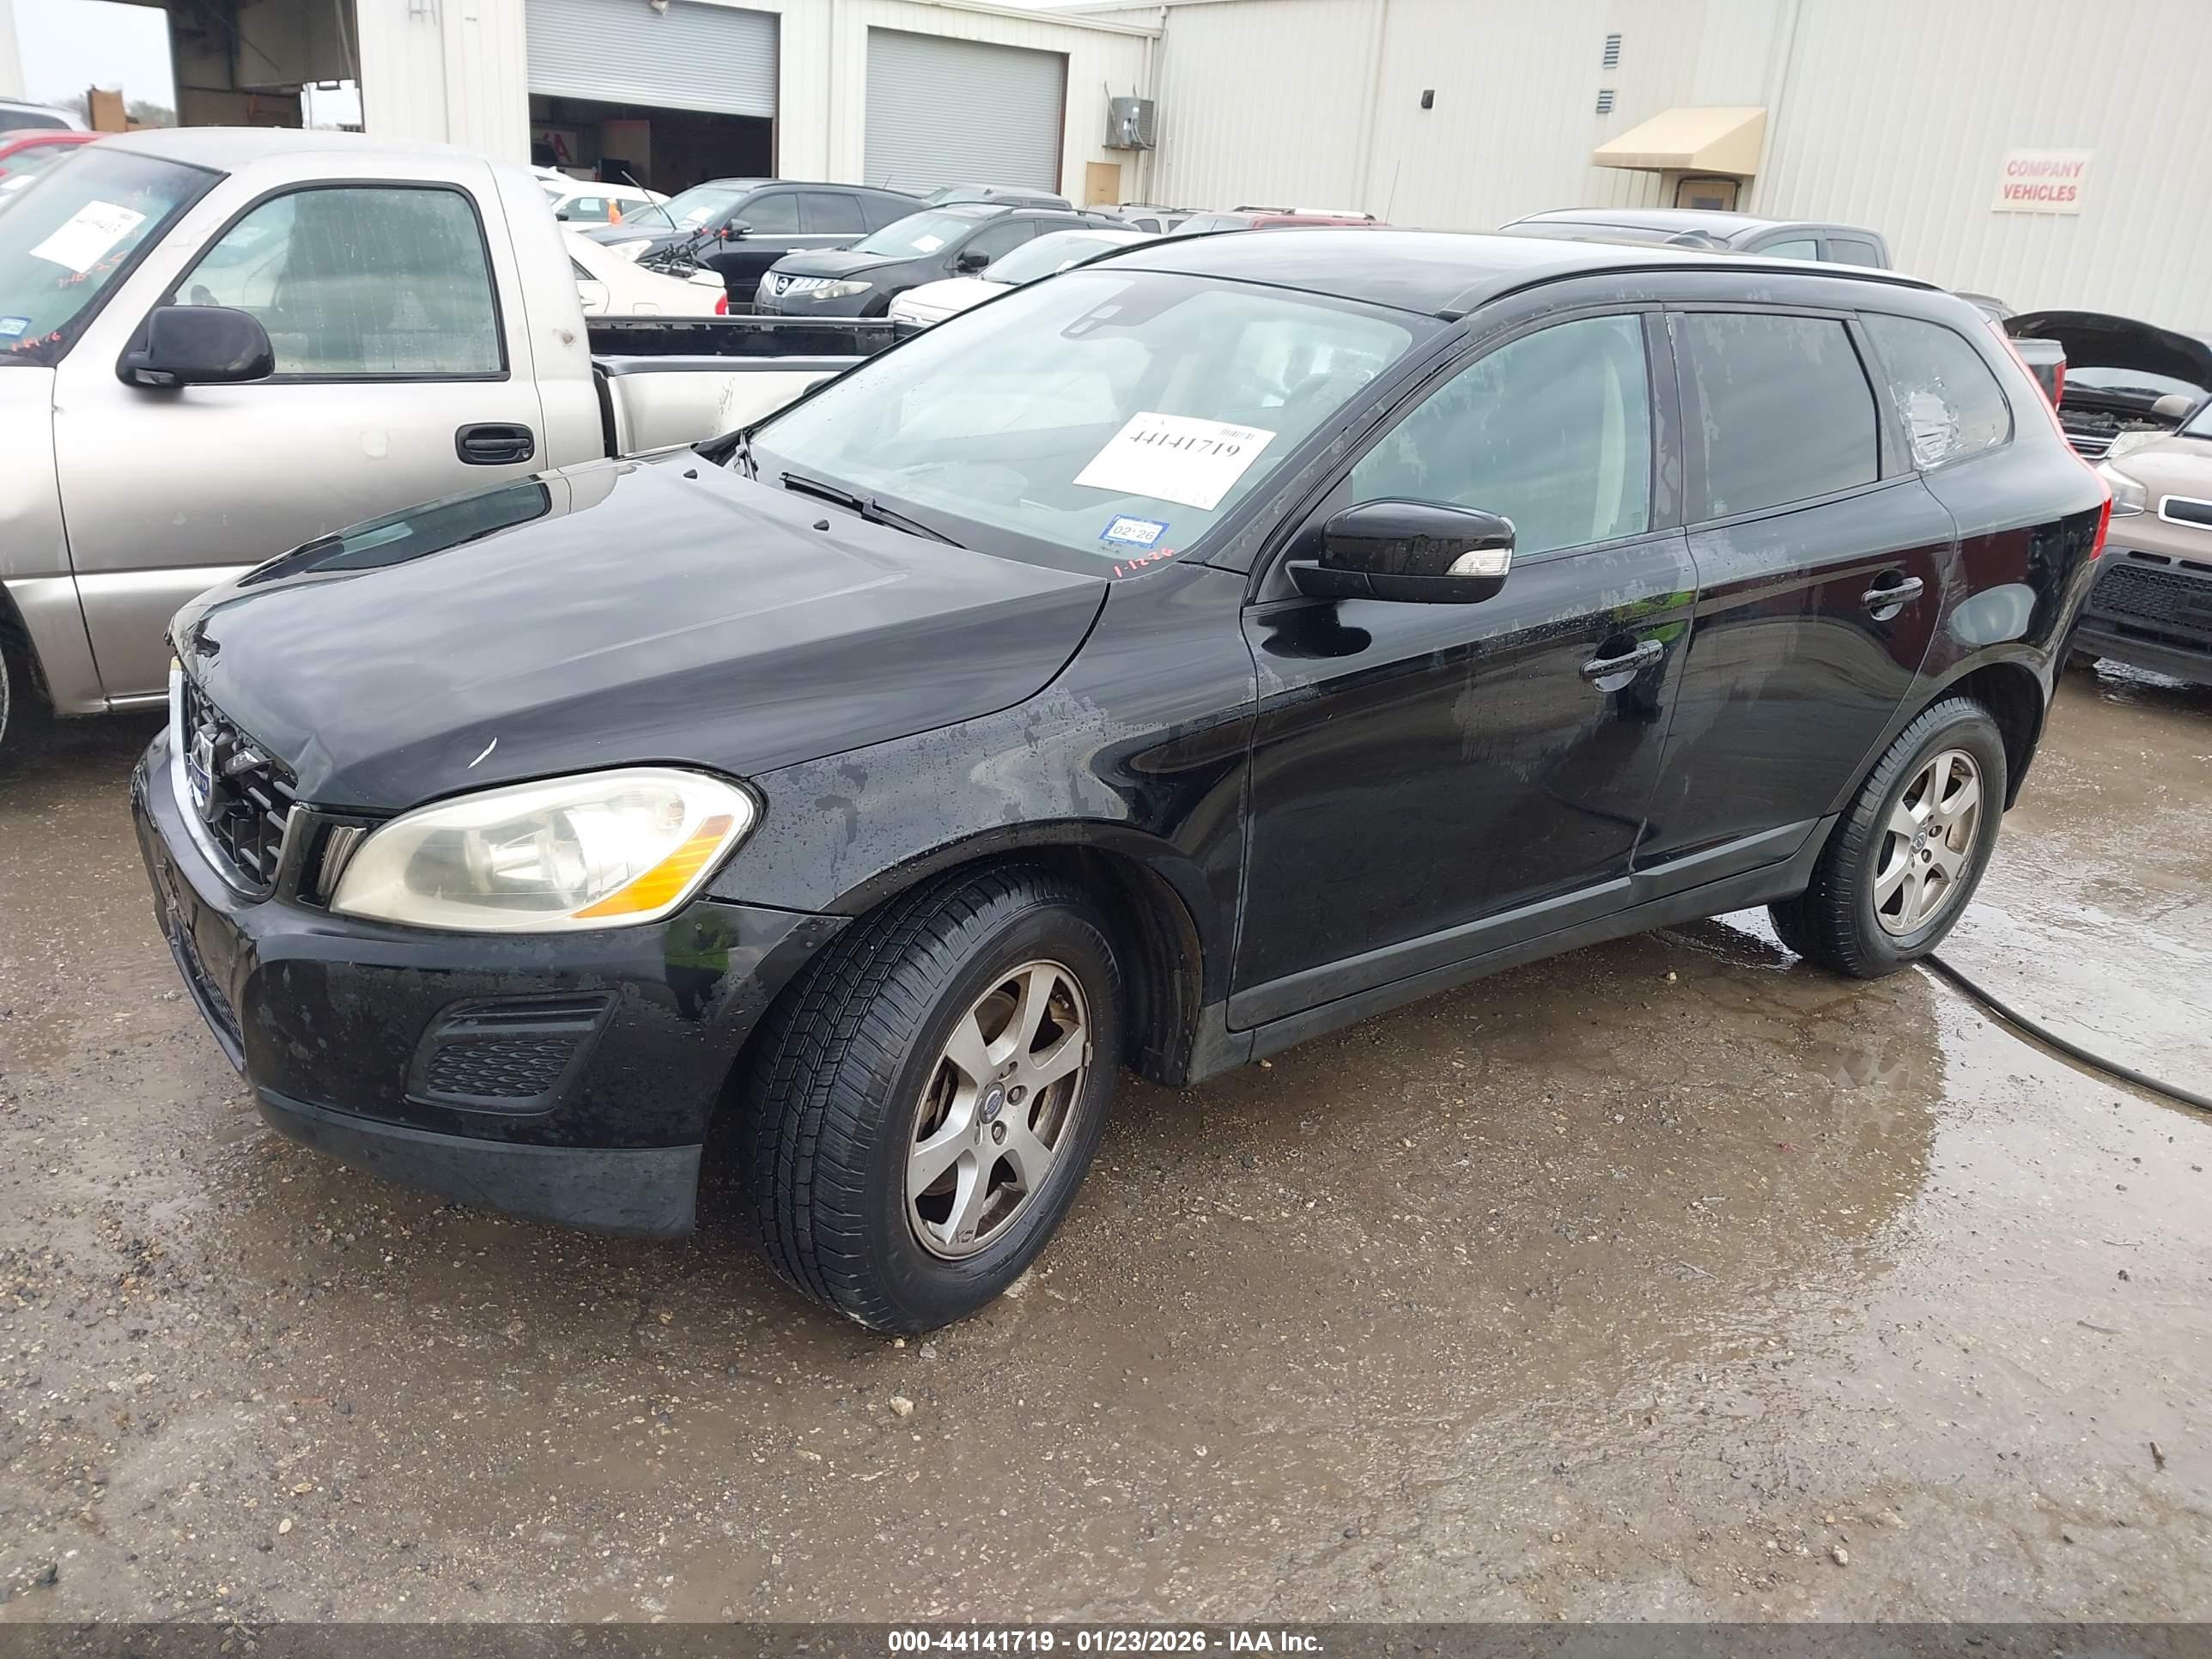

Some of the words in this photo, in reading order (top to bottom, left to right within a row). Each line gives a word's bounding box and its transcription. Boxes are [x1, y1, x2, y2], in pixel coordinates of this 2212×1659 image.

[2007, 159, 2085, 177] COMPANY
[2003, 183, 2077, 202] VEHICLES
[1129, 430, 1241, 457] 44141719
